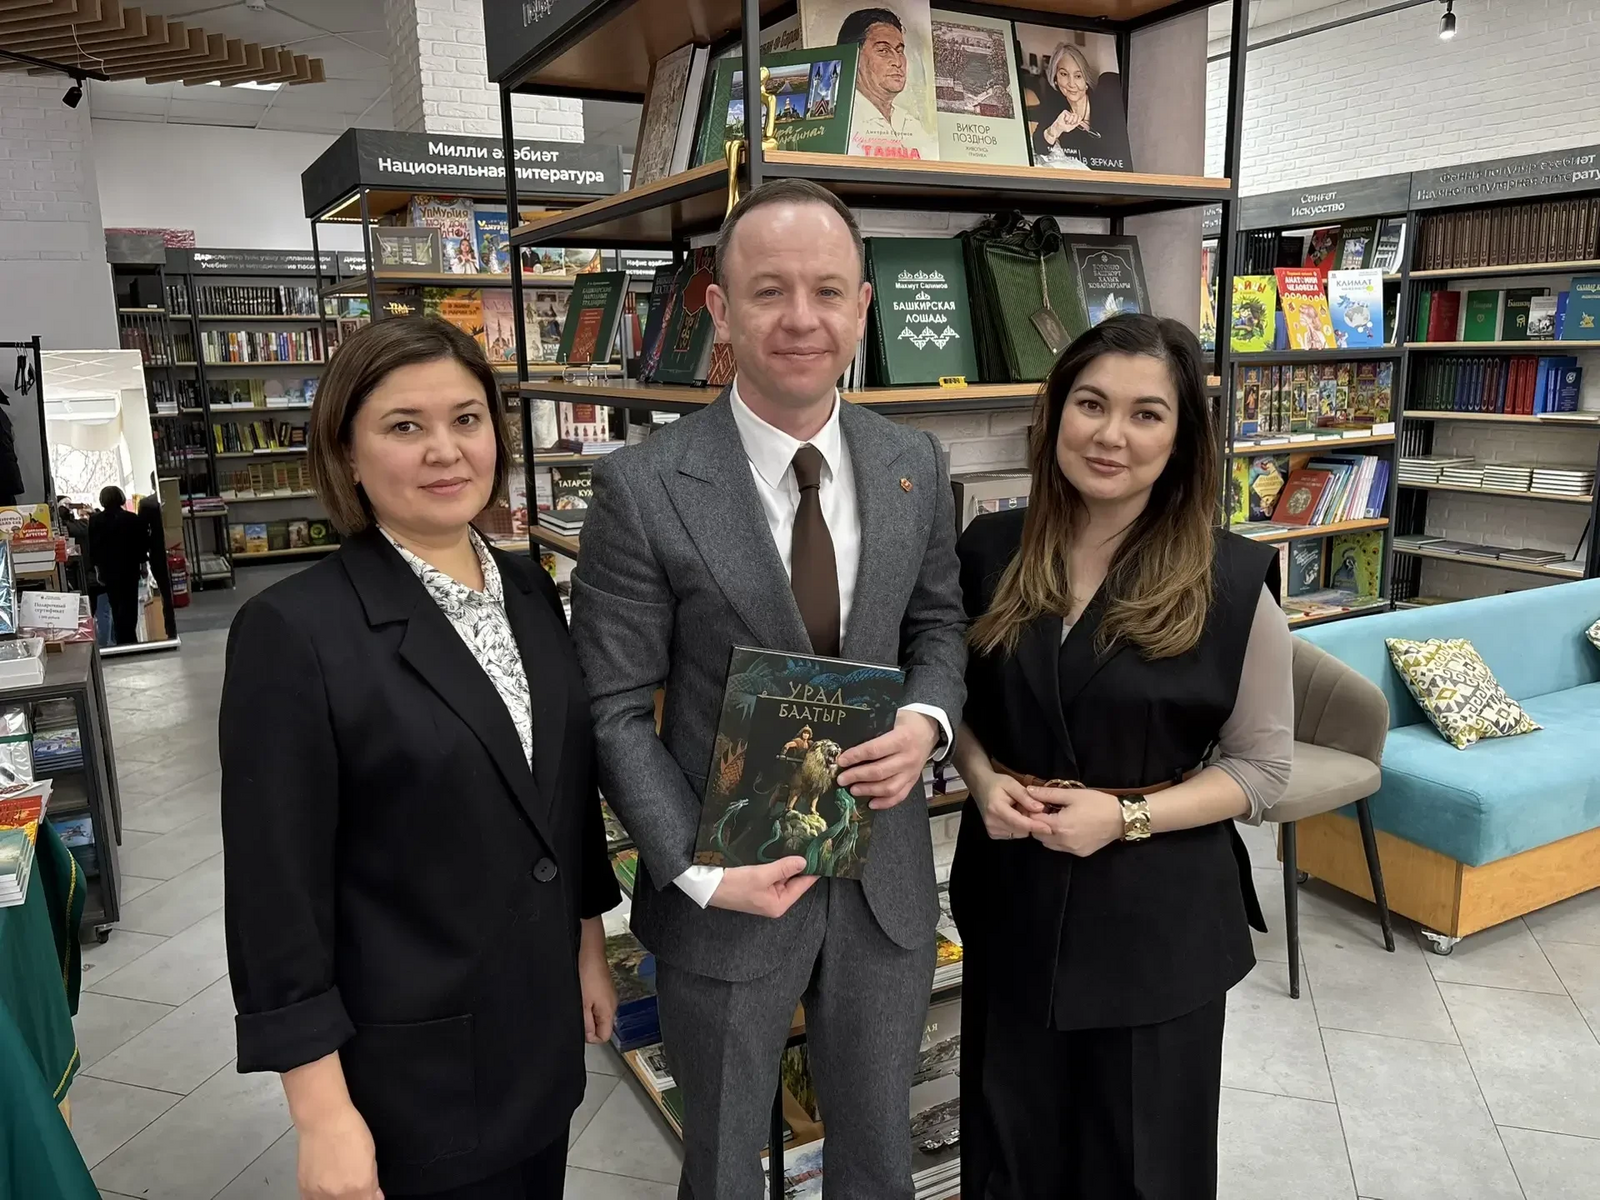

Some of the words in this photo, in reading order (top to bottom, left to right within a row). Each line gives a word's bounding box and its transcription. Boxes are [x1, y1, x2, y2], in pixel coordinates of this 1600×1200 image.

[956, 122, 991, 134] ВИКТОР
[952, 132, 998, 146] ПОЗДНОВ
[428, 141, 488, 159] Милли
[492, 147, 559, 163] әәбиәт
[378, 157, 506, 178] Национальная
[1082, 157, 1088, 166] В
[1090, 157, 1124, 169] ЗЕРКАЛЕ
[1540, 168, 1600, 185] литерату
[1291, 202, 1346, 217] Искусство
[895, 282, 919, 291] Махмут
[920, 282, 948, 290] Салимов
[1286, 283, 1319, 292] ЧЕЛОВЕКА
[1336, 279, 1372, 287] КЛИМАТ
[893, 301, 956, 311] БАШКИРСКАЯ
[905, 314, 948, 324] ЛОШАДЬ
[788, 680, 844, 706] УРАЛ
[778, 703, 847, 726] БААТЫР
